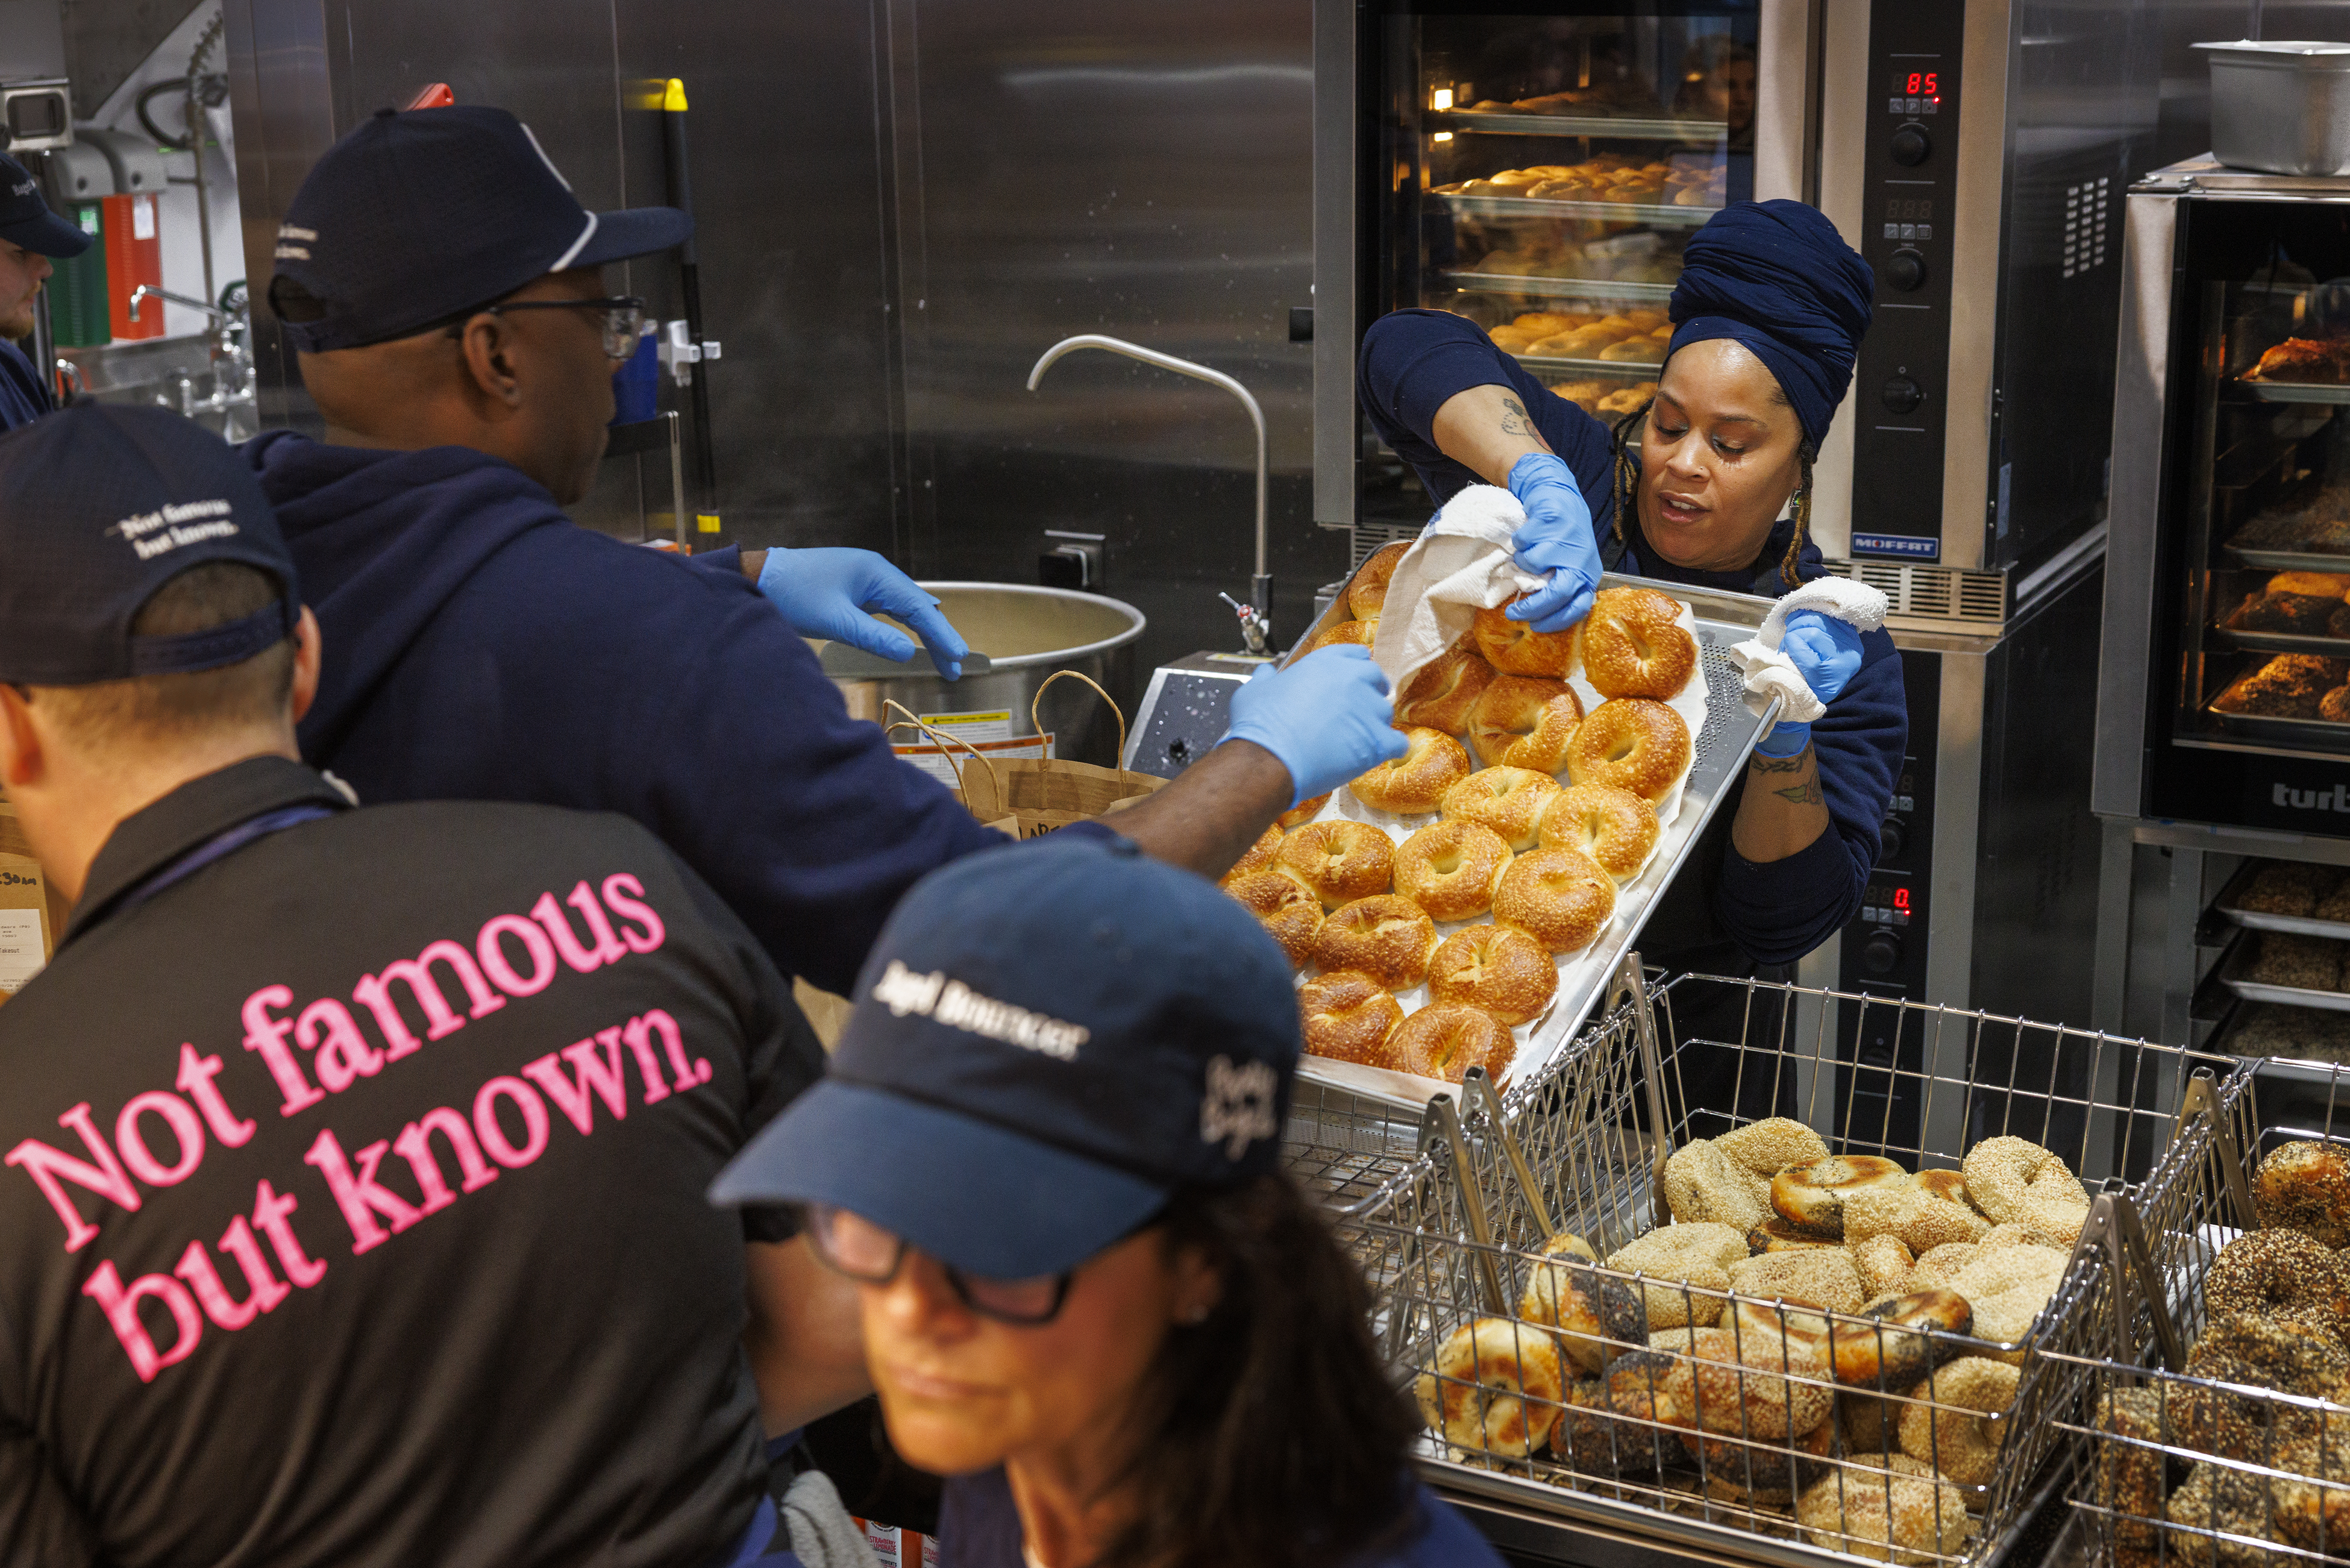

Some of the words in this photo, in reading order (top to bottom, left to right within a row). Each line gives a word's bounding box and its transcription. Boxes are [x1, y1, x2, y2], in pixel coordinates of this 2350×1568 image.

[1906, 73, 1937, 94] 85
[1855, 538, 1934, 552] MOFFAT
[4, 1041, 257, 1255] Not
[239, 871, 667, 1119] famous
[80, 1178, 329, 1384] but
[302, 1007, 713, 1256] known.
[869, 1535, 896, 1545] STRAWBERRY
[873, 1543, 897, 1553] LEMONADE
